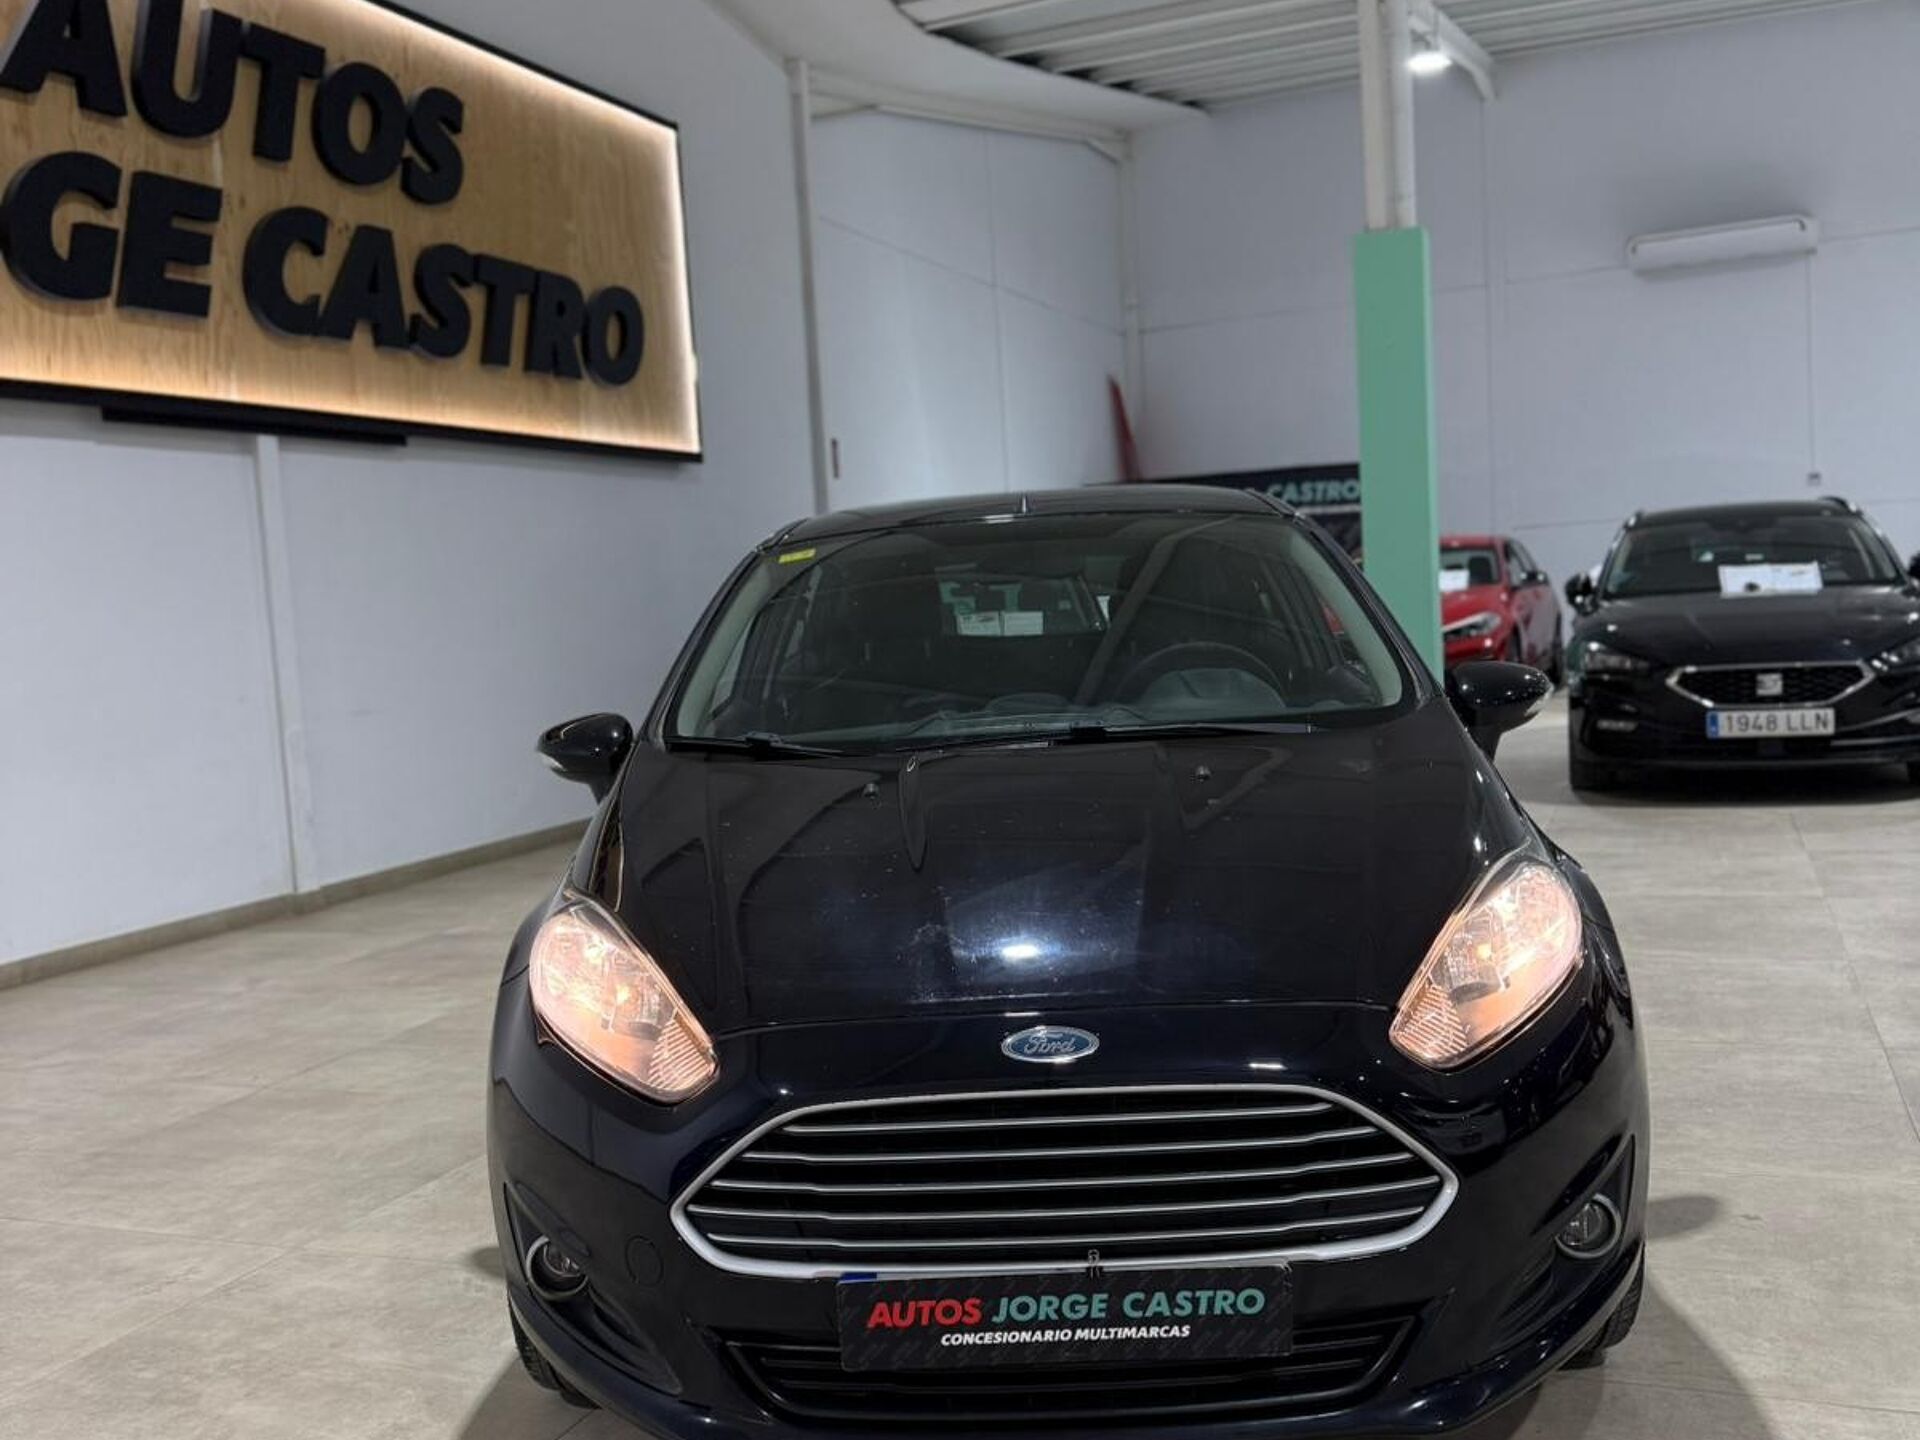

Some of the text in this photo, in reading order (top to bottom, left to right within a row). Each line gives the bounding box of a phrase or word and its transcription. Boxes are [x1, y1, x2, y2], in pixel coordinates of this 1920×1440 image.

[0, 0, 465, 205] AUTOS
[242, 206, 644, 386] CASTRO
[1726, 711, 1829, 733] 1948 LLN
[1023, 1032, 1076, 1054] Ford
[867, 1288, 1266, 1328] AUTOS JORGE CASTRO
[941, 1325, 1191, 1346] CONCESIONARIO MULTIMARCAS
